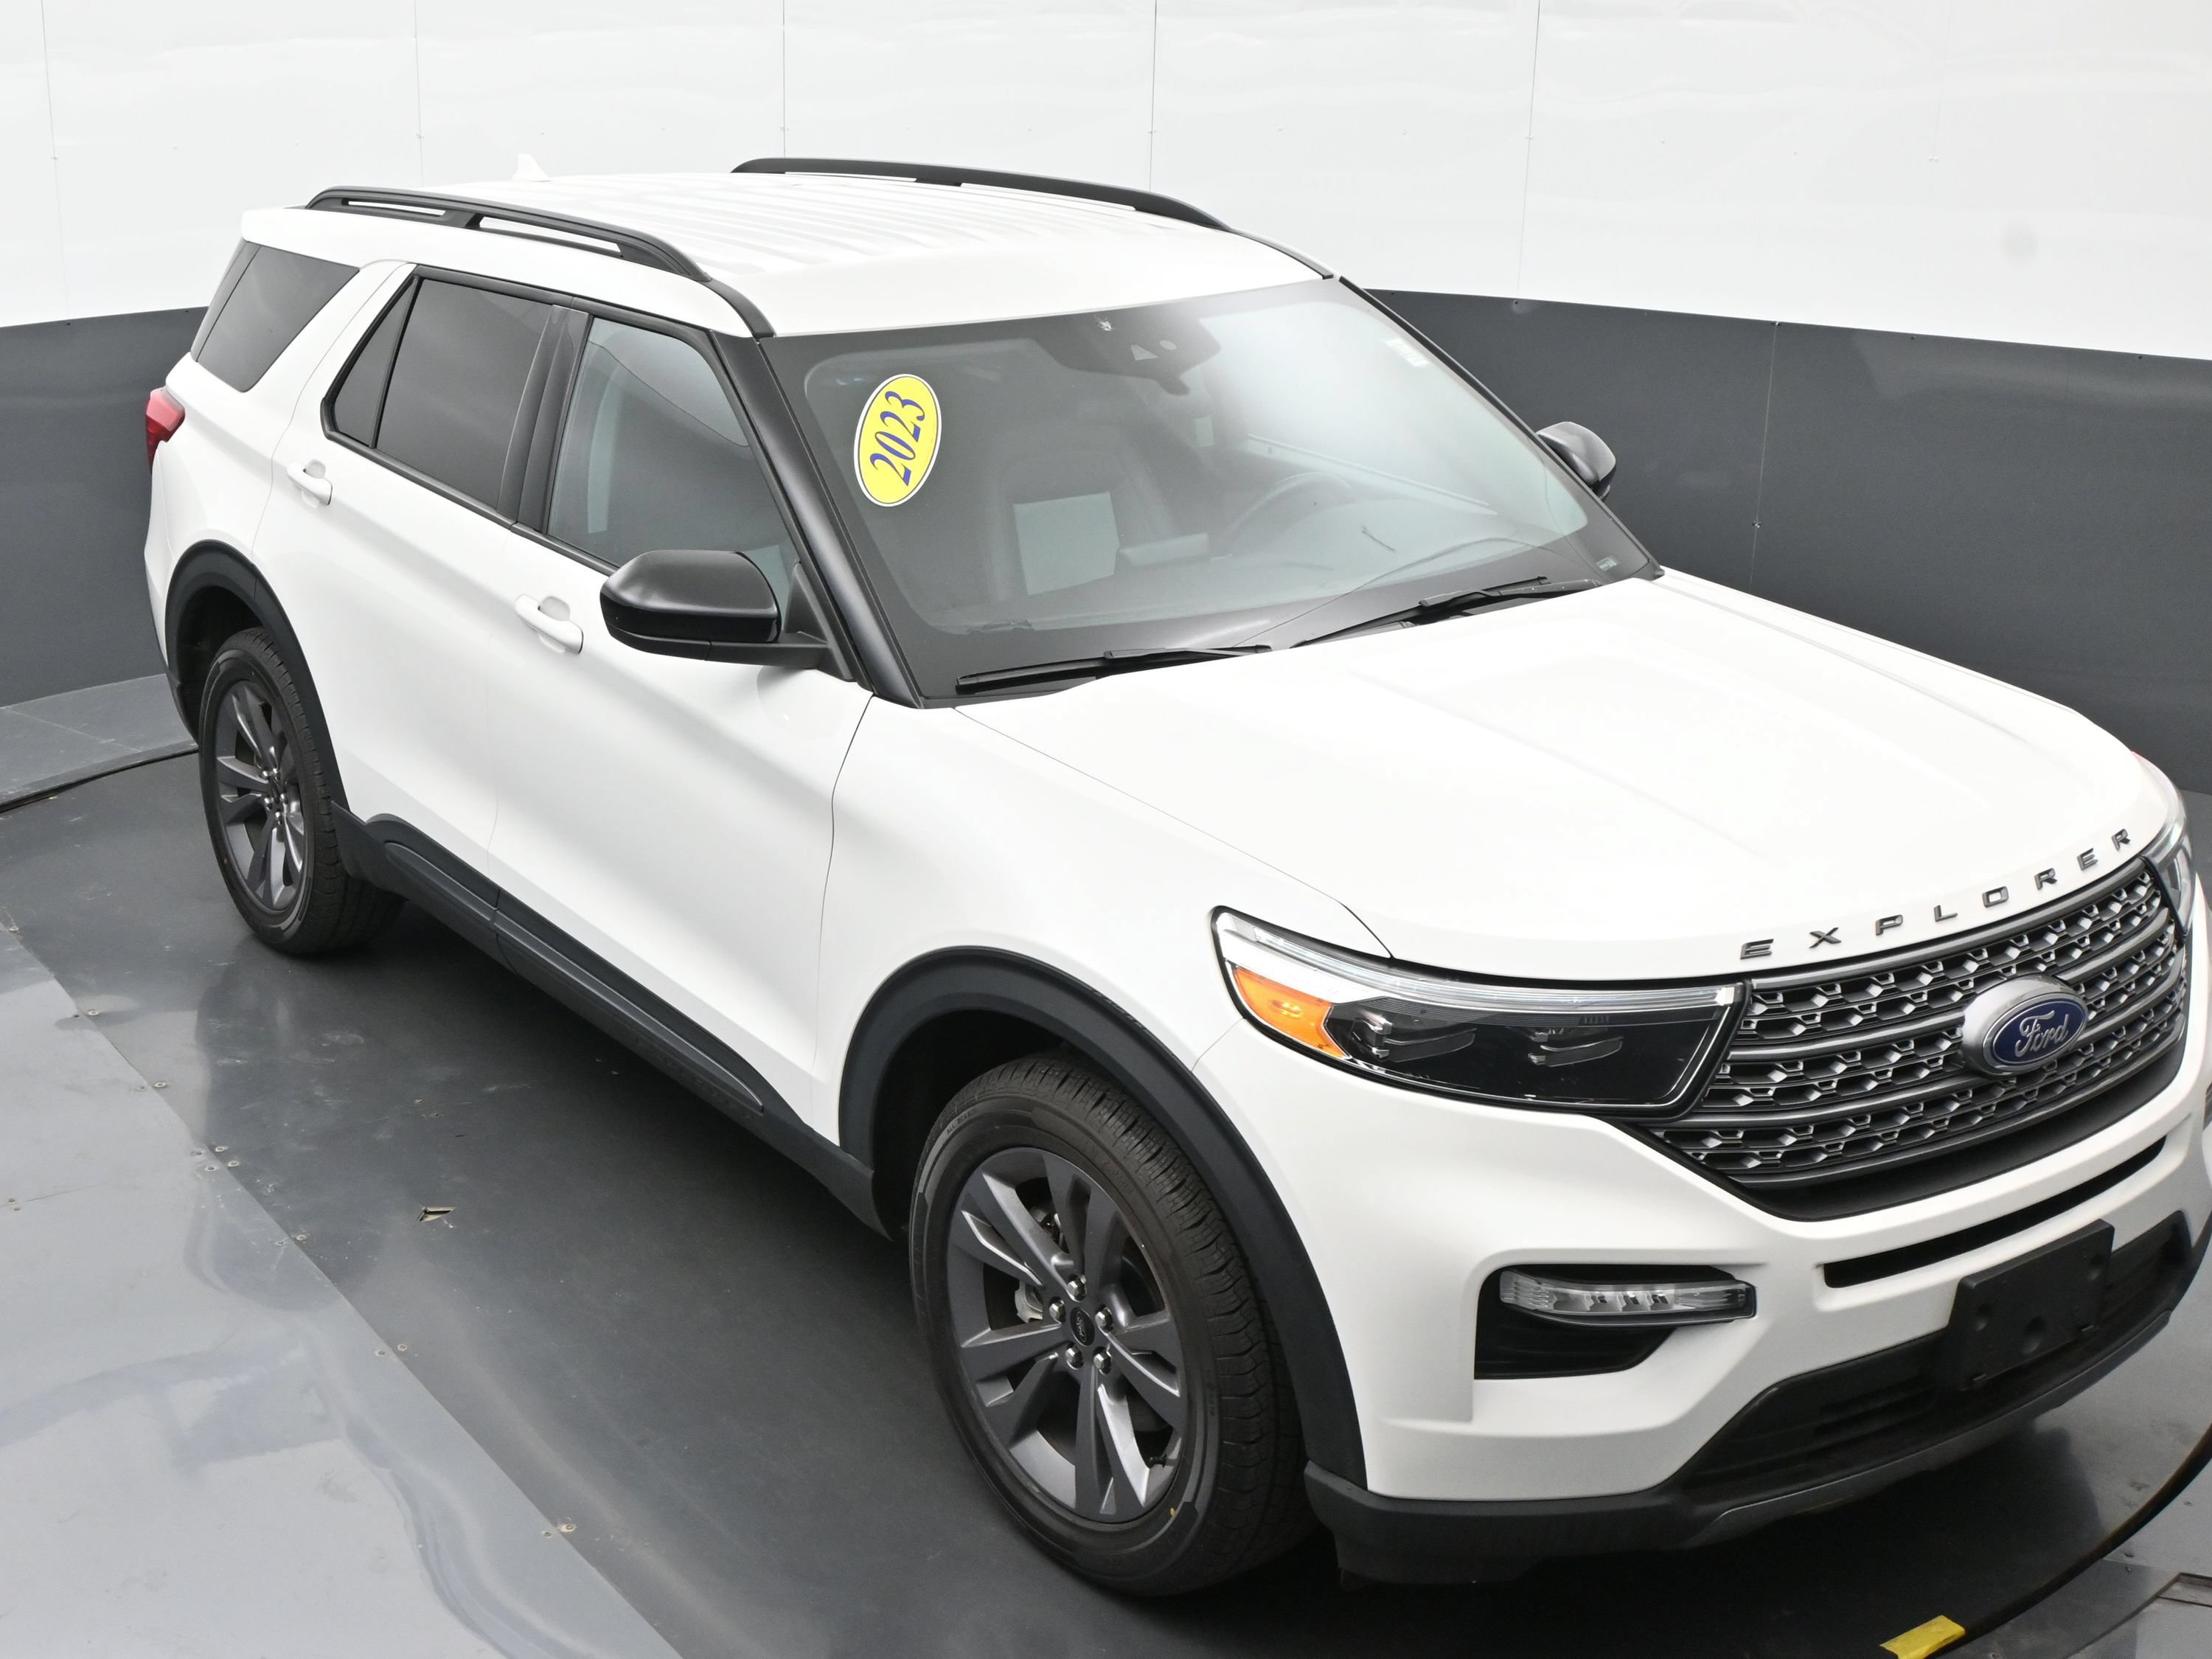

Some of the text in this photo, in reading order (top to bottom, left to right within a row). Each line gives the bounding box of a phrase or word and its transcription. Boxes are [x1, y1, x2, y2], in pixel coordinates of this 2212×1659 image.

[870, 391, 925, 487] 2023
[1739, 828, 2132, 960] EXPLORER
[2014, 1009, 2070, 1057] Ford
